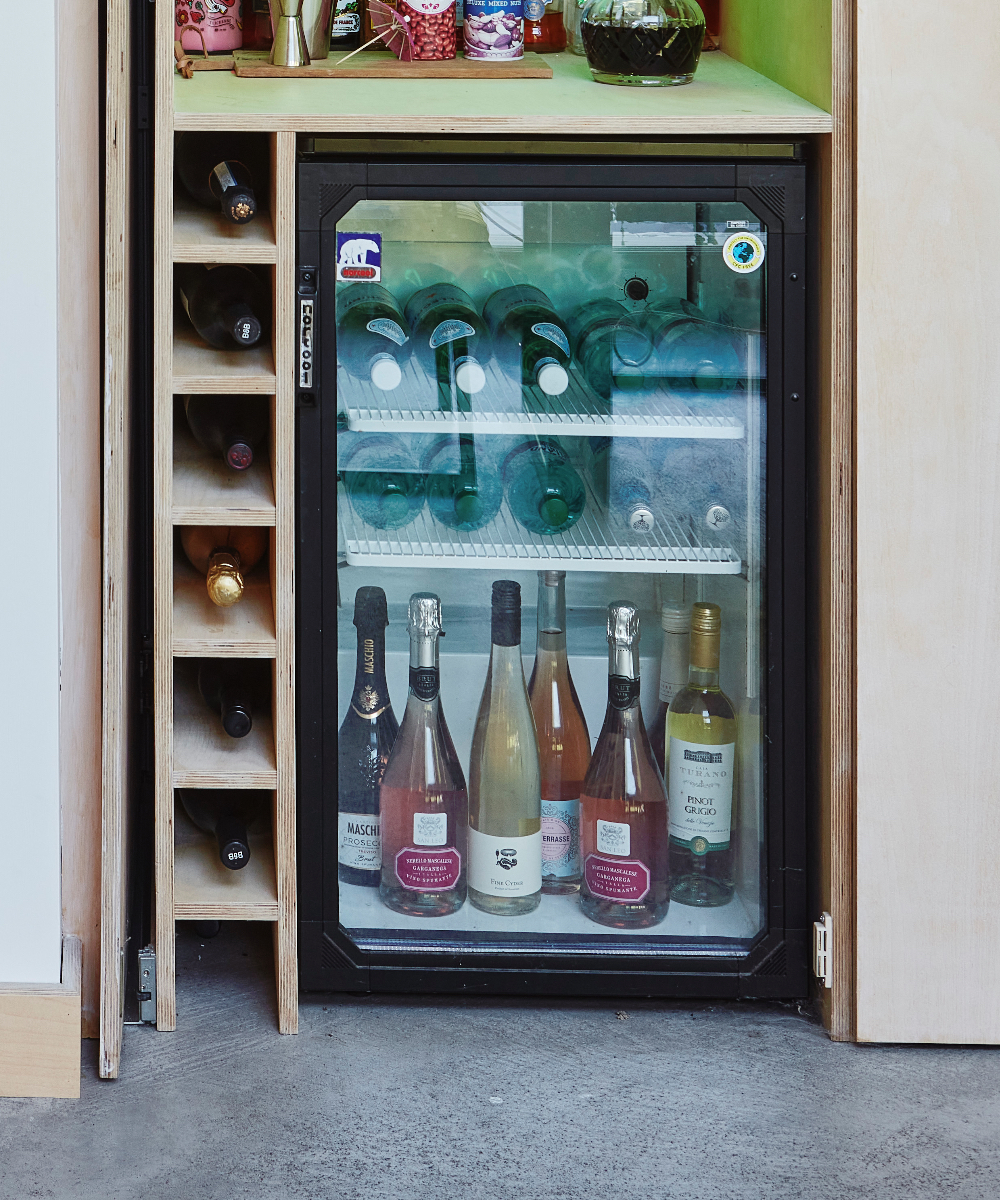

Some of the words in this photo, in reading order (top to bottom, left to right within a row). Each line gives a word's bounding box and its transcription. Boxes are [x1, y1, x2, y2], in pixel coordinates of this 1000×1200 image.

[343, 269, 374, 277] norcool
[364, 639, 374, 674] MASCHIO
[679, 766, 727, 778] TURANO
[687, 795, 713, 806] PINOT
[684, 805, 717, 816] GRIGIO
[347, 822, 380, 836] MASCHI
[343, 836, 380, 846] PROSEC
